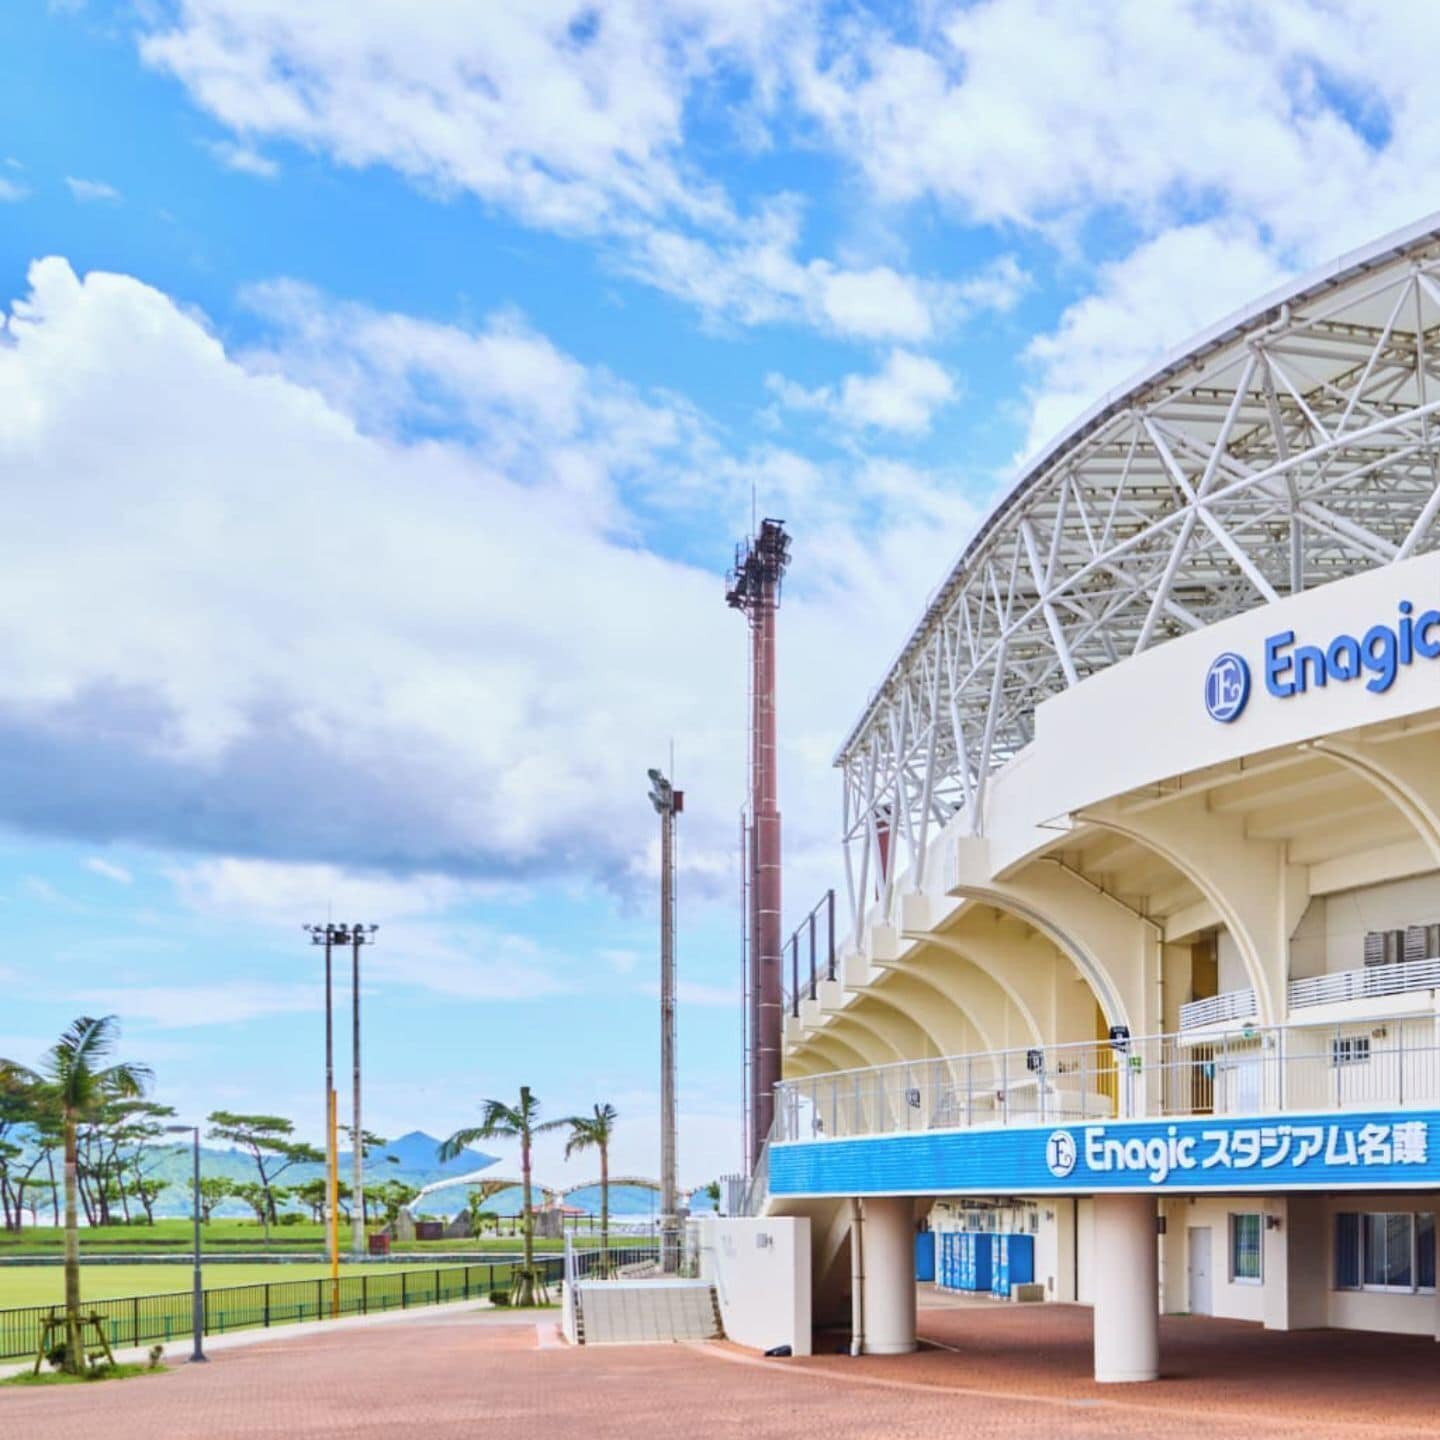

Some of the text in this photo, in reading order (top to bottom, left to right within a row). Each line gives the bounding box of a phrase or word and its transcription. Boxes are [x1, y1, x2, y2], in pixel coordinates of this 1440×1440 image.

[1085, 1126, 1197, 1184] Enagic
[1202, 1121, 1429, 1168] スタジアム名護
